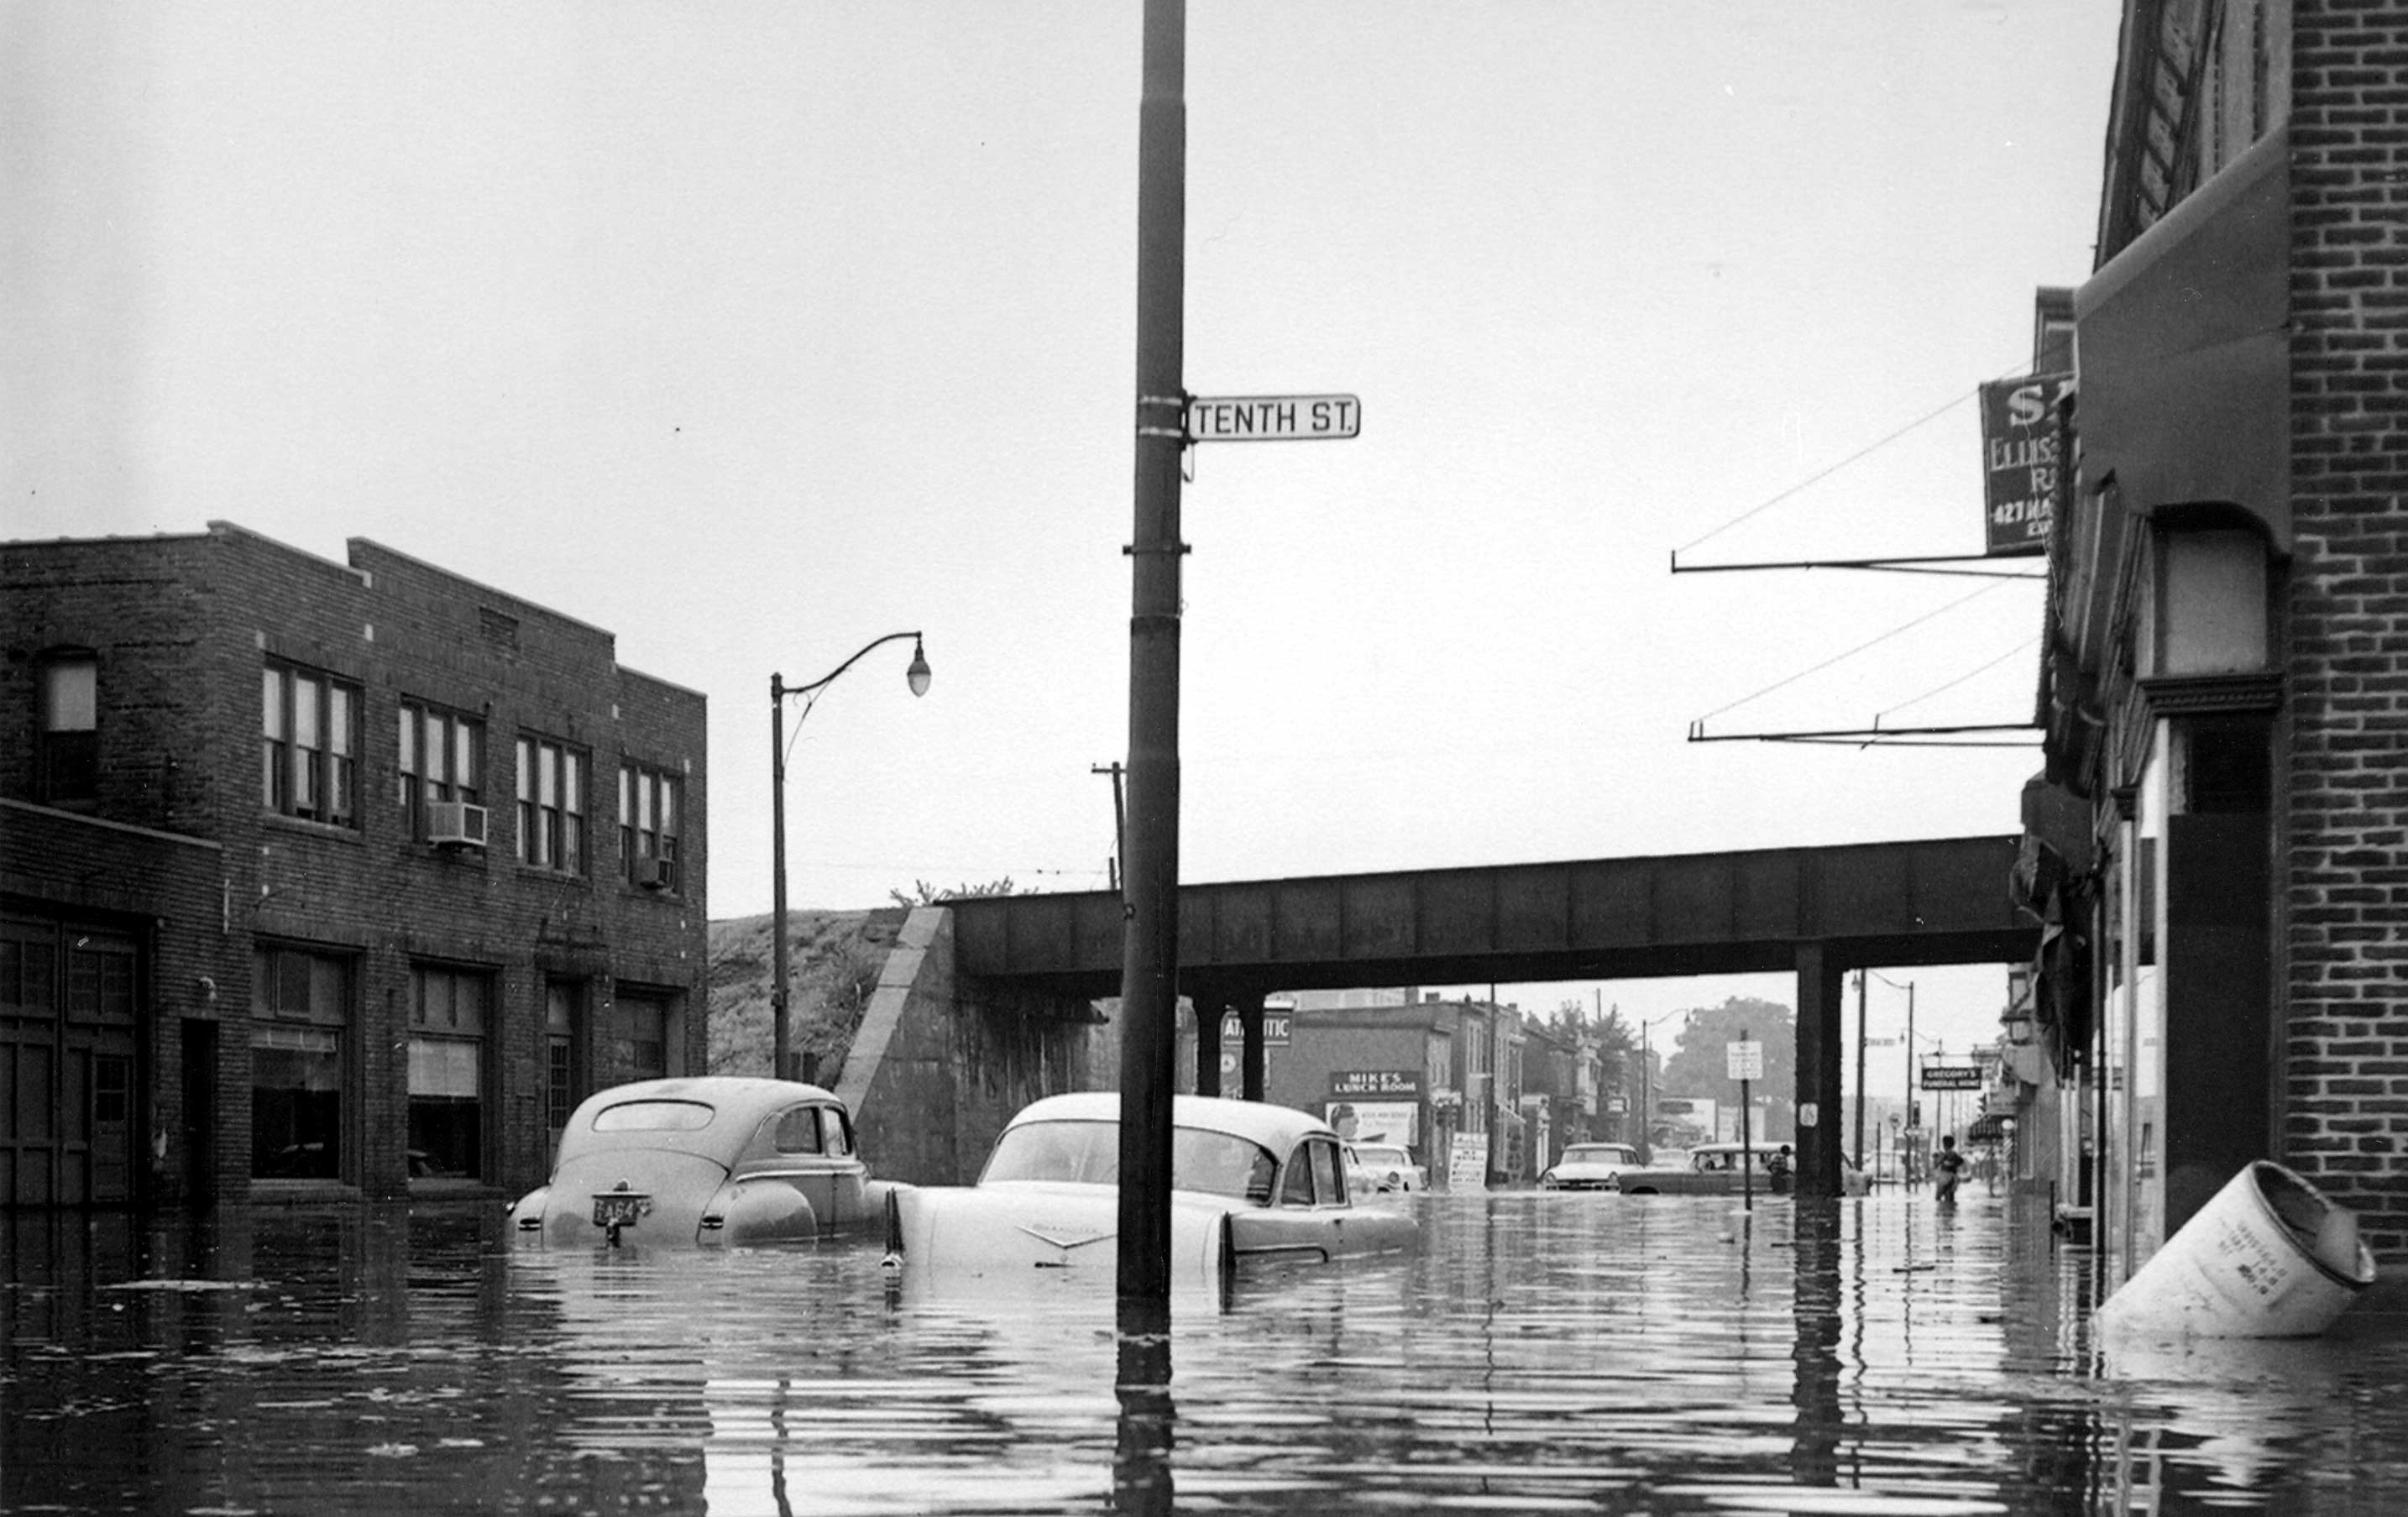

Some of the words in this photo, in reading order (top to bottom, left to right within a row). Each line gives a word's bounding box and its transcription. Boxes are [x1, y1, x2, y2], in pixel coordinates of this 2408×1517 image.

[1195, 402, 1296, 434] TENTH
[1311, 400, 1353, 432] ST.
[1993, 500, 2024, 523] 427
[1348, 1072, 1401, 1083] MIKE'S
[1333, 1082, 1378, 1092] LUNCH
[1379, 1081, 1416, 1092] ROOM
